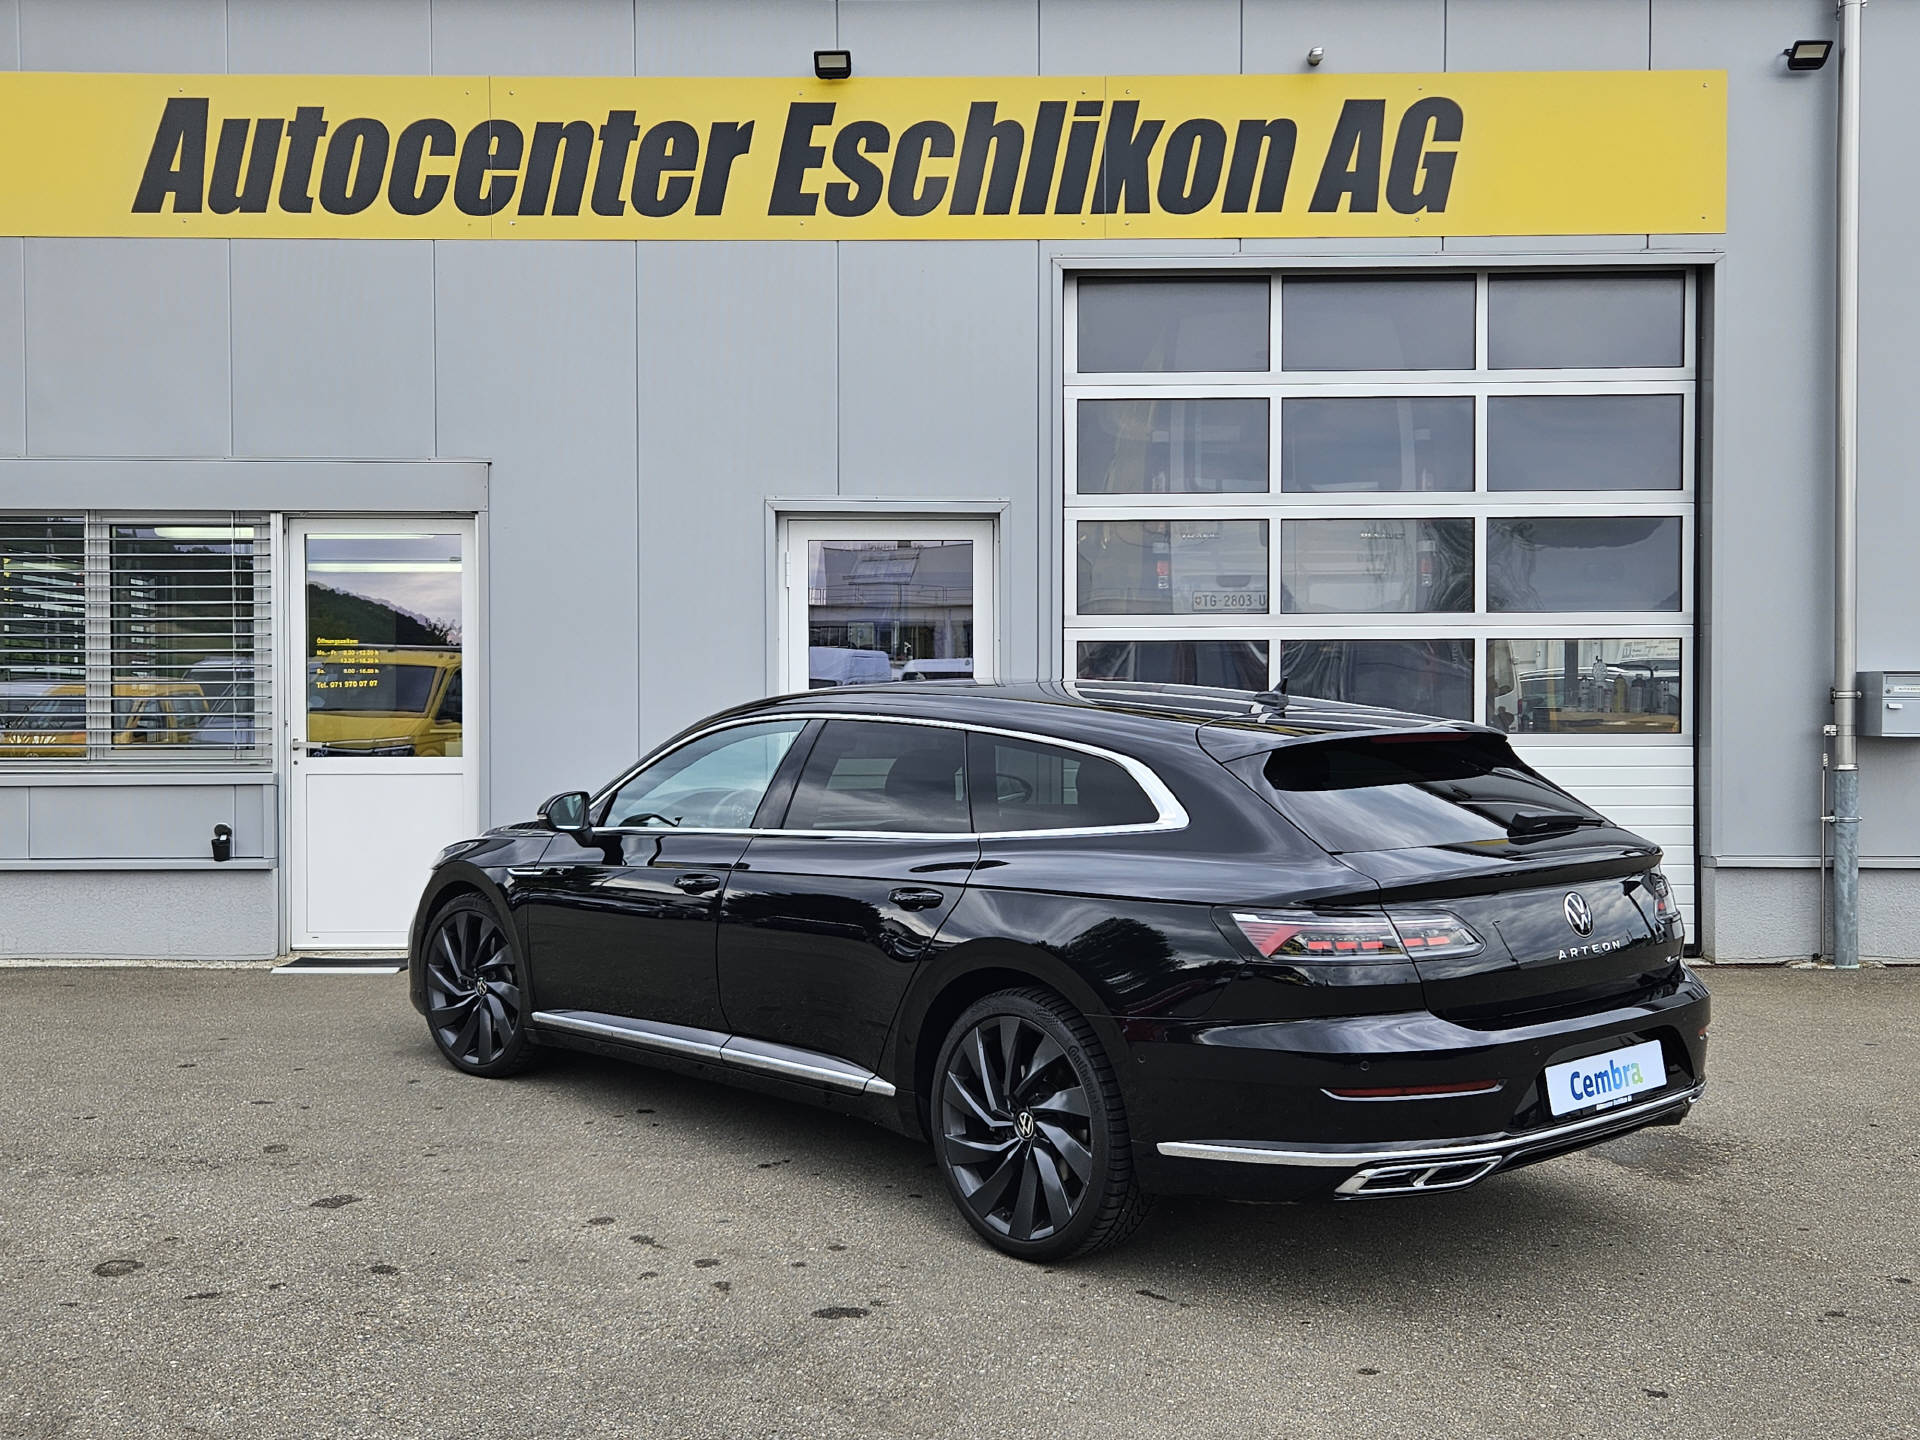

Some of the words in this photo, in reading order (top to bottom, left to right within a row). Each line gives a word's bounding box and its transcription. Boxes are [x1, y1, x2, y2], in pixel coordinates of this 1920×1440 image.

[131, 97, 755, 217] Autocenter
[768, 100, 1300, 217] Eschlikon
[1308, 96, 1464, 214] AG
[1558, 940, 1621, 960] ARTEON
[1569, 1060, 1644, 1101] Cembra
